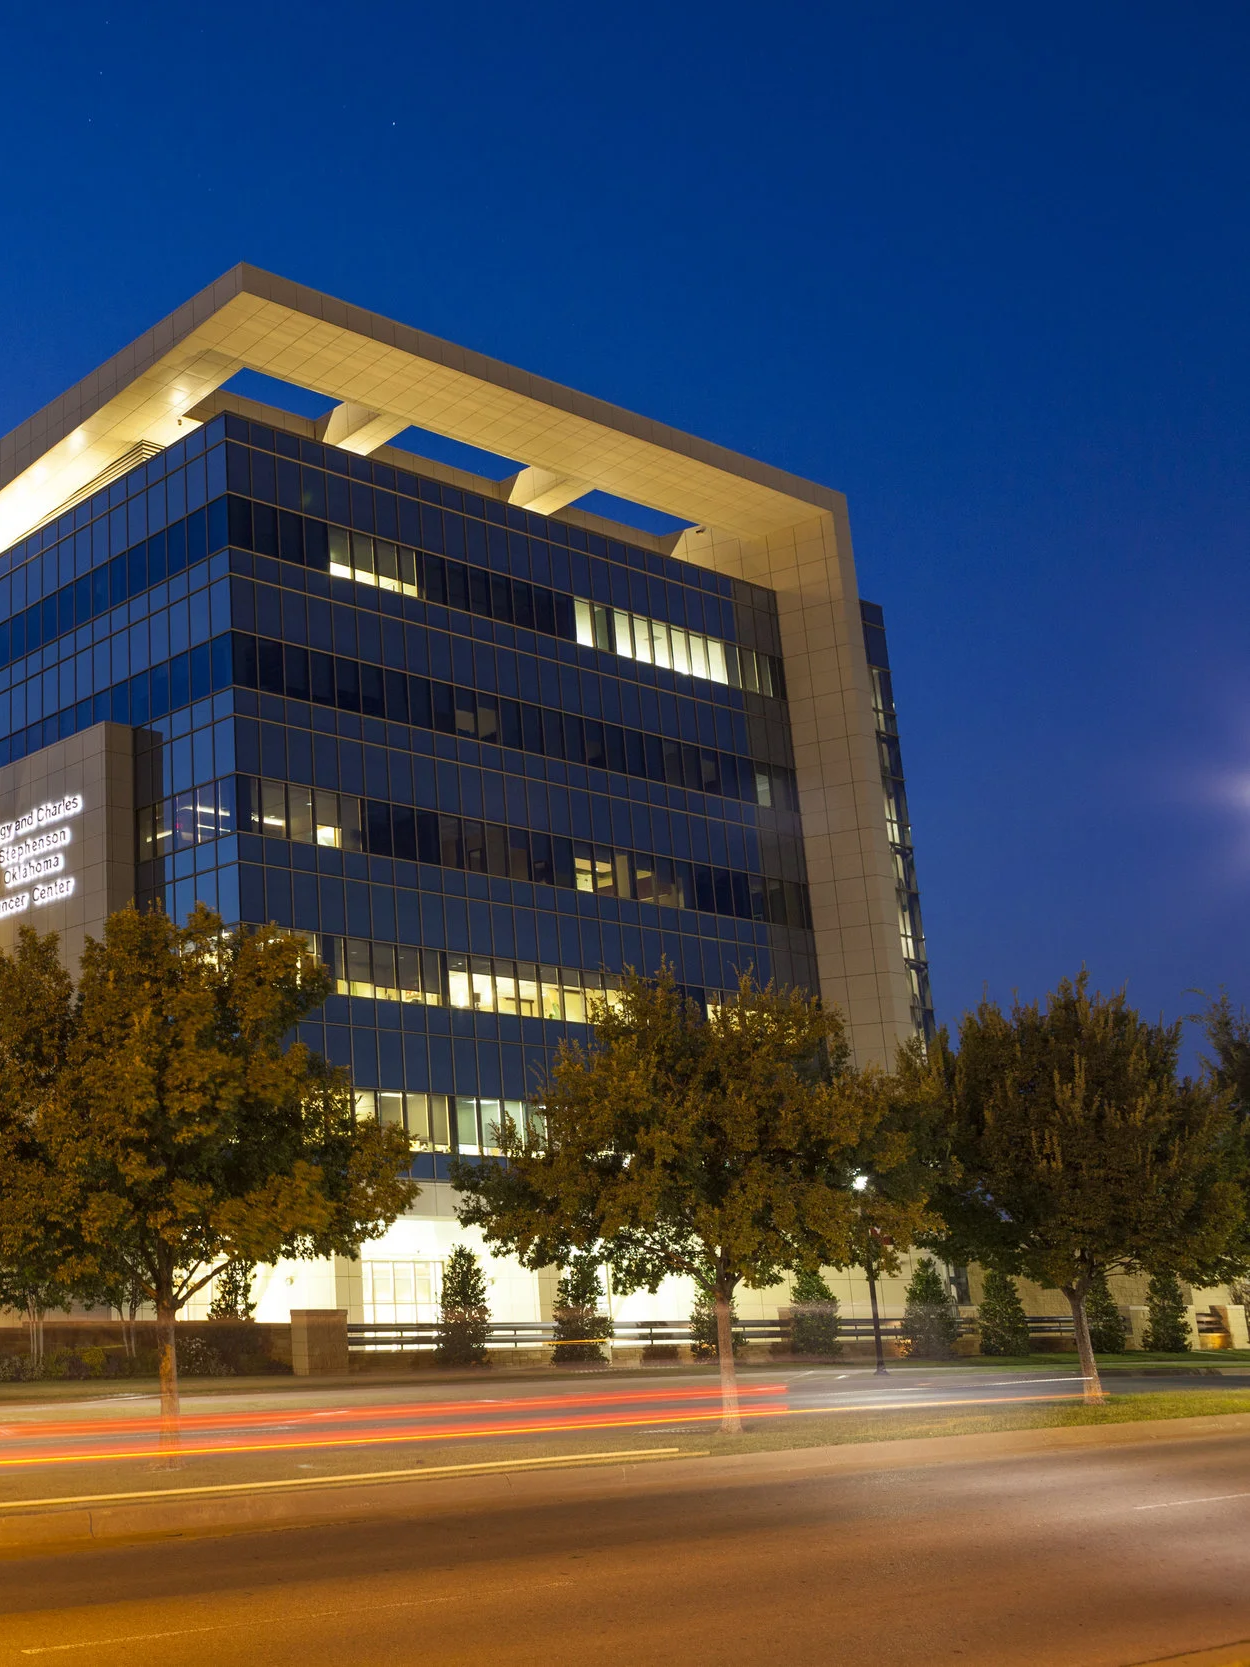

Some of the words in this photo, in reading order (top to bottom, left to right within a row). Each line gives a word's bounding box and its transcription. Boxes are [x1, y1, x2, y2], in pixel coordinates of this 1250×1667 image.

[15, 811, 34, 832] and
[37, 796, 80, 823] Charles
[4, 855, 60, 885] Oklahoma
[32, 878, 72, 903] Center
